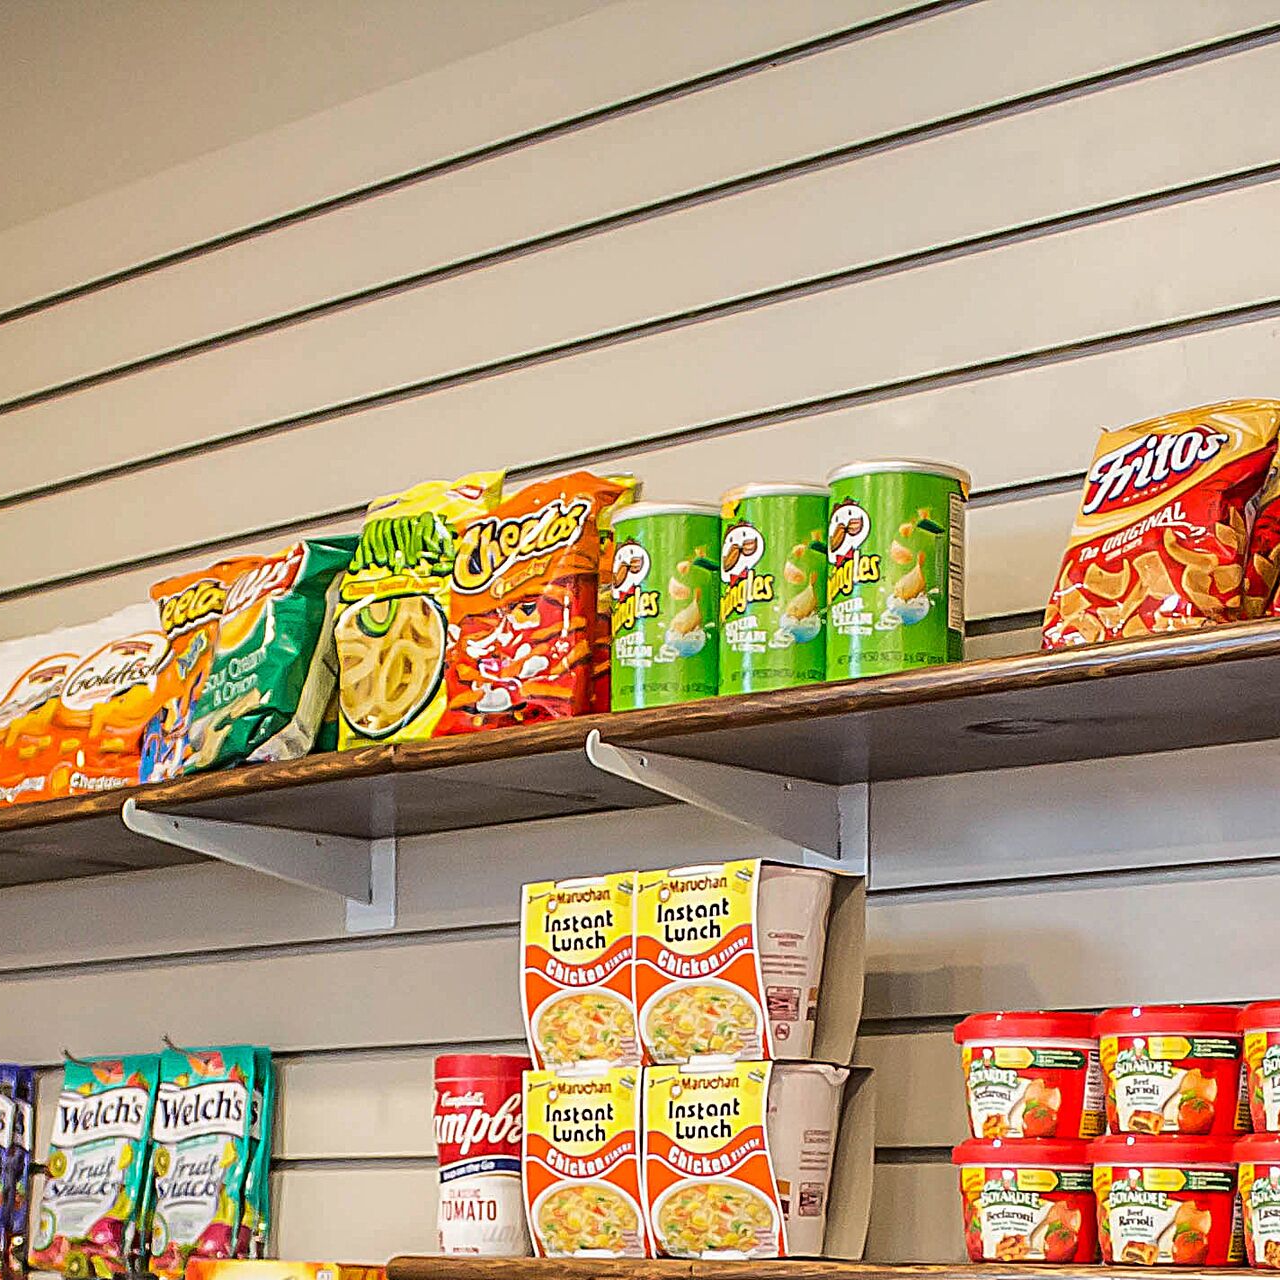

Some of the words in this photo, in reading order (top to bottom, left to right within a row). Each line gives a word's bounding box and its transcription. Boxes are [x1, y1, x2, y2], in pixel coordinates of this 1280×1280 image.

[1083, 429, 1229, 516] Fritos
[1102, 502, 1186, 553] ORIGINAL
[455, 502, 588, 589] Cheetos
[545, 910, 613, 933] Instant
[656, 898, 730, 923] Instant
[552, 931, 606, 952] Lunch
[664, 919, 721, 942] Lunch
[545, 958, 604, 985] Chicken
[657, 949, 719, 977] Chicken
[1115, 1060, 1172, 1077] BOYARDEE
[62, 1096, 143, 1134] Welch's
[160, 1090, 242, 1129] Welch's
[546, 1103, 614, 1122] Instant
[668, 1098, 740, 1120] Instant
[553, 1123, 606, 1142] Lunch
[675, 1119, 732, 1140] Lunch
[545, 1148, 604, 1177] Chicken
[668, 1145, 730, 1174] Chicken
[442, 1200, 497, 1221] TOMATO
[980, 1191, 1040, 1209] BOYARDEE
[1109, 1191, 1168, 1209] BOYARDEE
[986, 1209, 1034, 1222] Beefaroni
